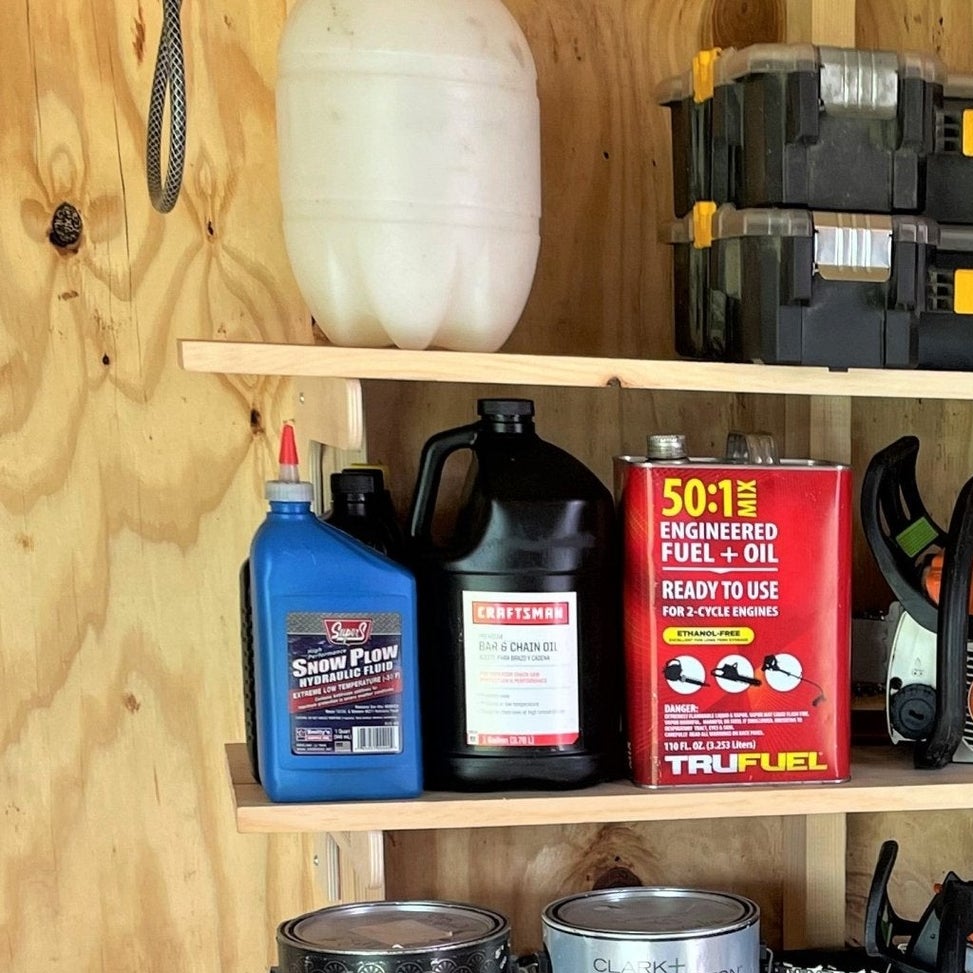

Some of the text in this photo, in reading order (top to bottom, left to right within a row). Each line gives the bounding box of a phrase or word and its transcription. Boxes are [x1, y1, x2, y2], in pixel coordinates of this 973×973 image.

[662, 477, 758, 518] 50:1 MIX
[660, 521, 778, 541] ENGINEERED
[661, 542, 779, 563] FUEL + OIL
[662, 580, 779, 600] READY TO USE
[477, 606, 563, 620] CRAFTSMAN
[662, 605, 779, 617] FOR 2-CYCLE ENGINES
[479, 641, 498, 652] BAR
[510, 641, 541, 652] CHAIN
[543, 641, 558, 652] OIL
[292, 645, 398, 678] SNOW PLOW
[299, 661, 393, 688] HYDRAULIC FLUID
[293, 688, 322, 699] EXTREME
[323, 685, 336, 694] LOW
[338, 676, 381, 690] TEMPERATURE
[664, 704, 699, 713] DANGER:
[664, 742, 679, 751] 110
[681, 741, 691, 750] FL.
[693, 741, 705, 750] OZ.
[731, 740, 756, 749] Liters)
[664, 751, 828, 775] TRUFUEL
